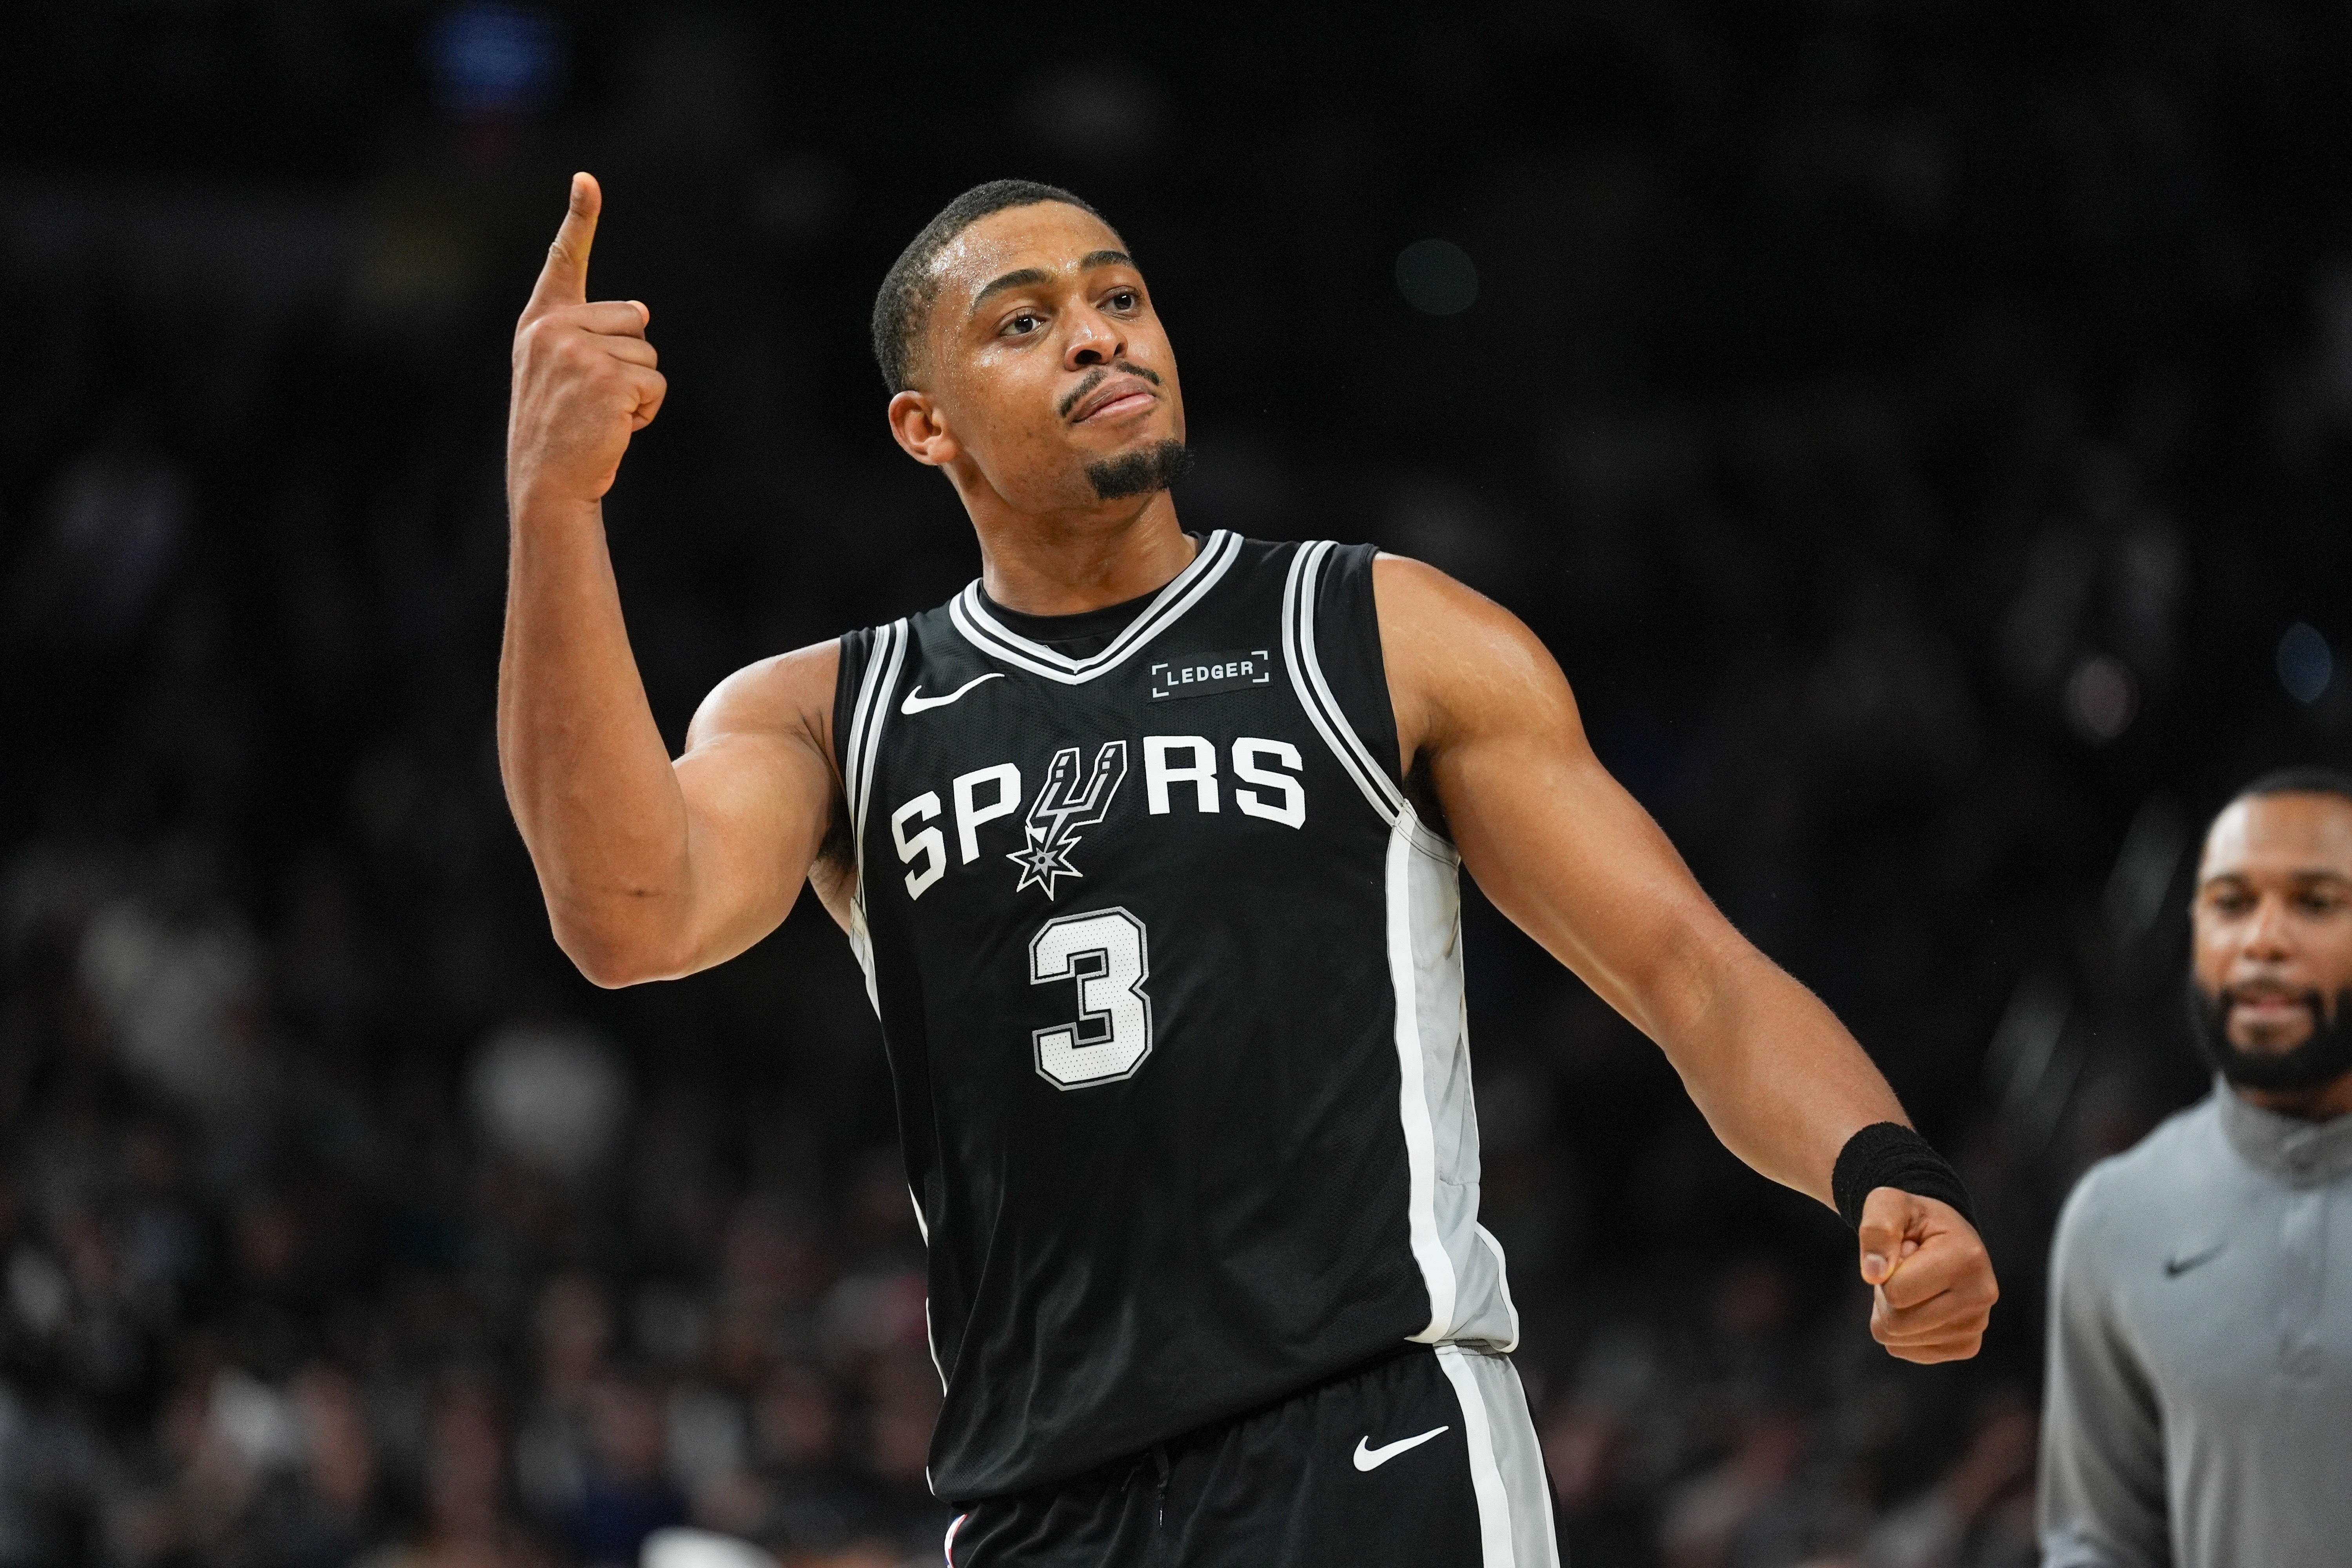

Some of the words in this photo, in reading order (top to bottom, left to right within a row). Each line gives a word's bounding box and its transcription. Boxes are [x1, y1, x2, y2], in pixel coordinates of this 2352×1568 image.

[1167, 661, 1253, 686] LEDGER
[891, 735, 1306, 901] SPURS
[1028, 906, 1152, 1092] 3
